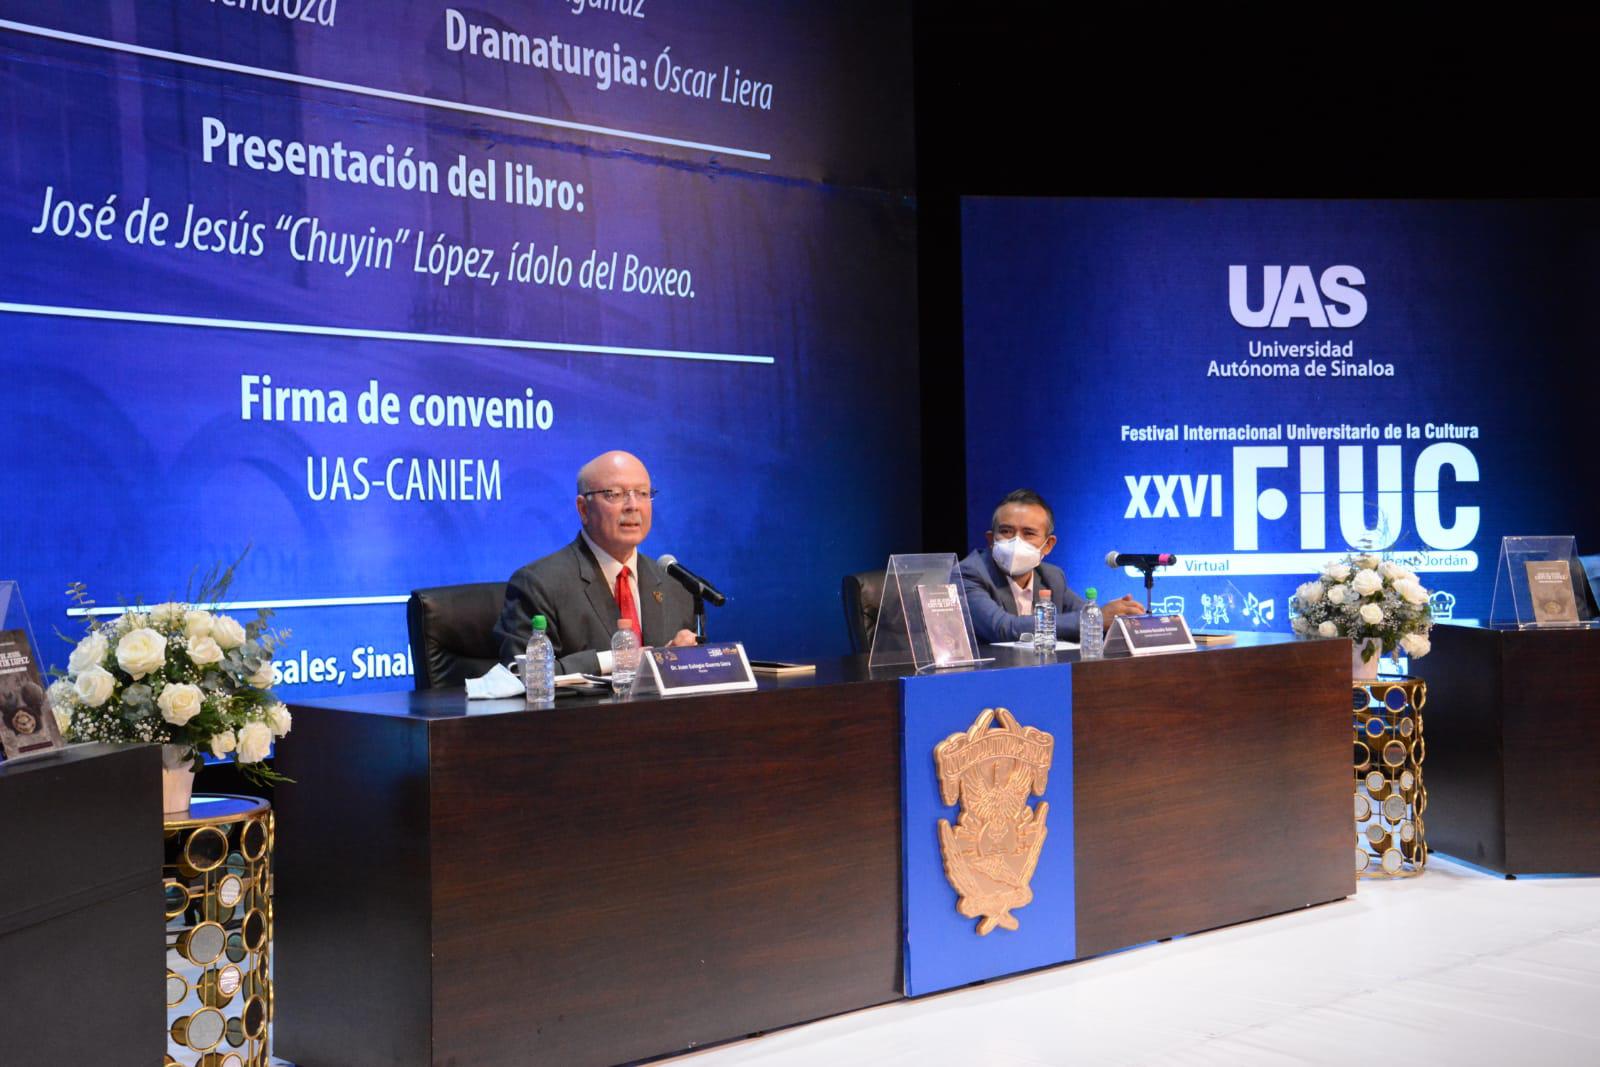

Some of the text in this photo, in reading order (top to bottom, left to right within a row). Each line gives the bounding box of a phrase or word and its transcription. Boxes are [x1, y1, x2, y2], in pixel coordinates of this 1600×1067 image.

[446, 8, 772, 109] Dramaturgia: Óscar Liera
[203, 117, 584, 212] Presentación del libro:
[32, 187, 116, 240] José
[125, 198, 168, 246] de
[175, 204, 265, 256] Jesús
[414, 231, 499, 285] López,
[508, 242, 572, 286] ídolo
[579, 250, 617, 290] del
[622, 254, 694, 298] Boxeo.
[1229, 265, 1367, 327] UAS
[1207, 359, 1394, 376] Autónoma de Sinaloa
[1249, 340, 1353, 357] Universidad
[242, 375, 553, 430] Firma de convenio
[1122, 423, 1478, 441] Festival Internacional Universitario de la Cultura
[308, 457, 501, 500] UAS-CANIEM
[1124, 443, 1480, 550] XXVI FIUC
[1185, 560, 1230, 572] Virtual
[271, 645, 413, 685] sales, Sinal
